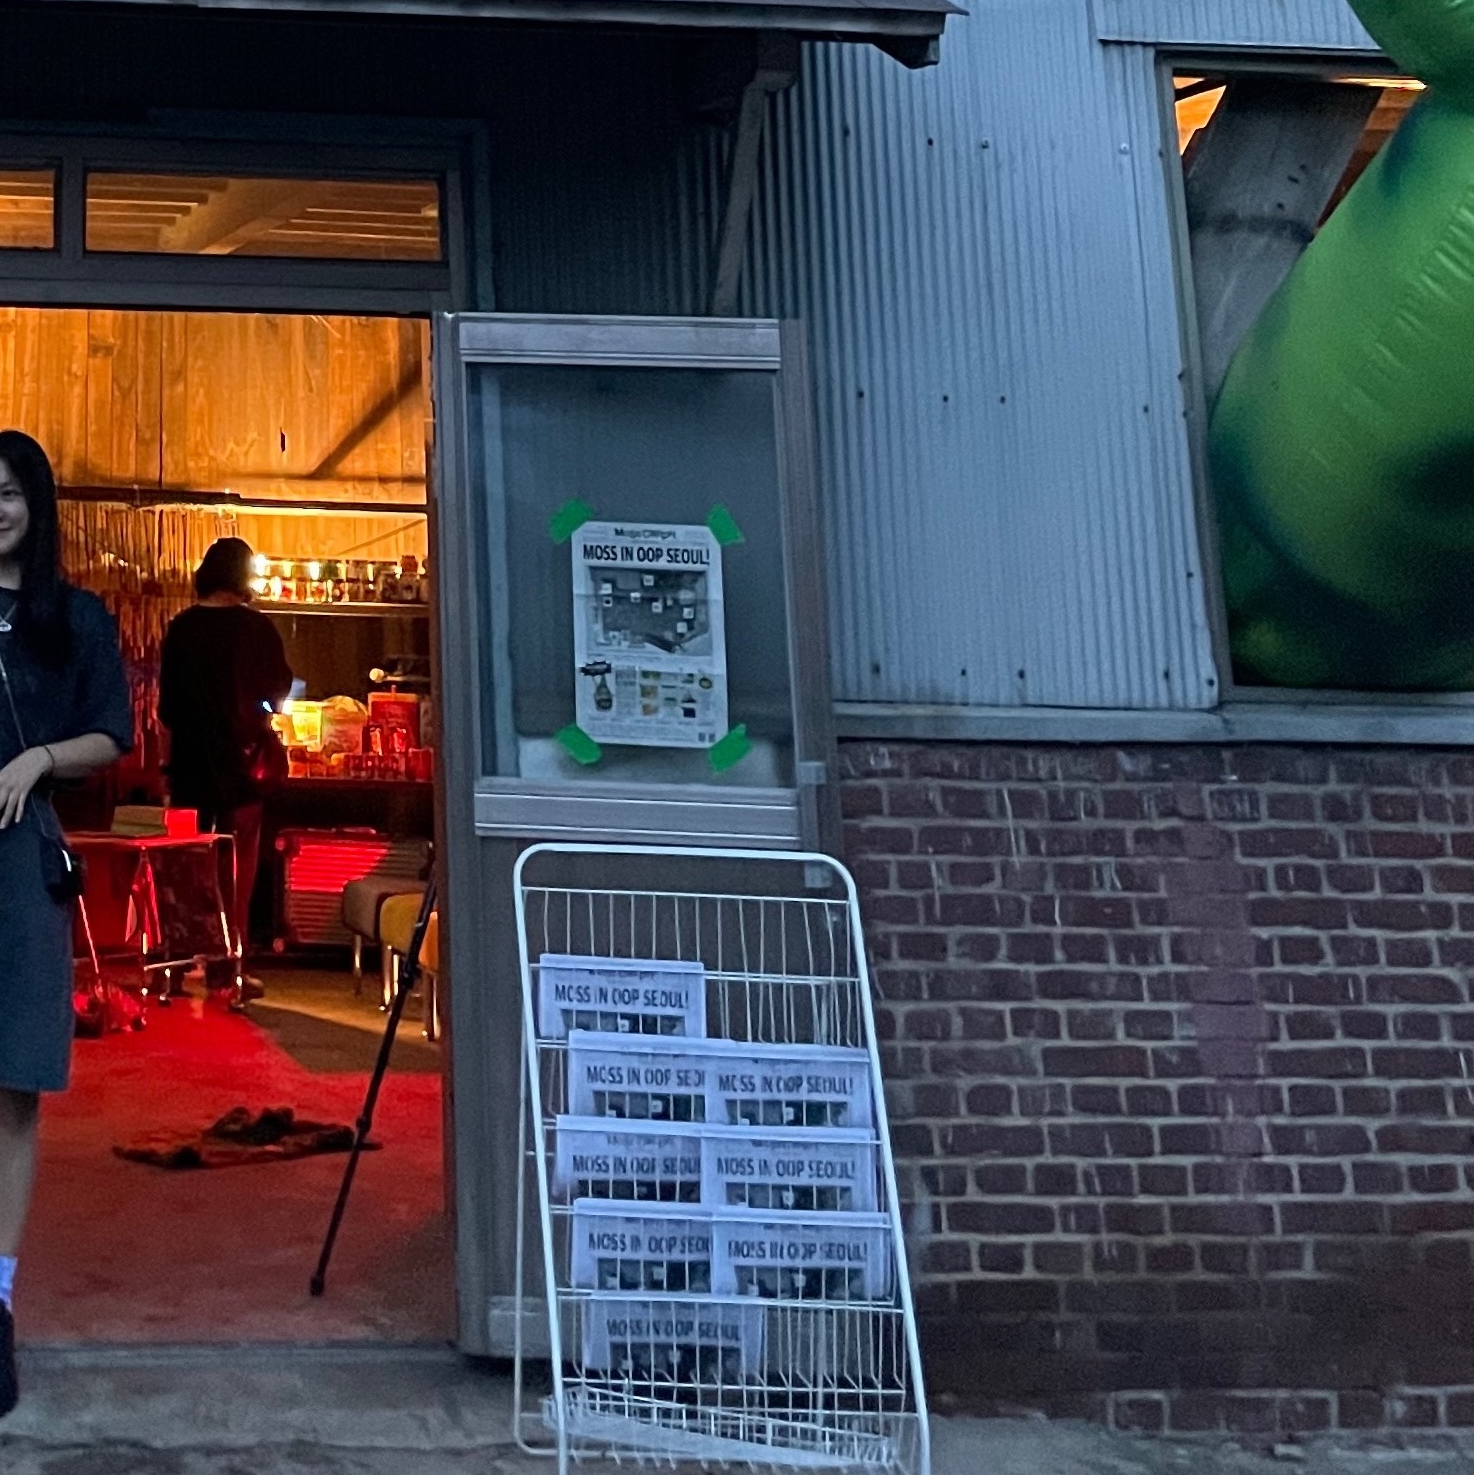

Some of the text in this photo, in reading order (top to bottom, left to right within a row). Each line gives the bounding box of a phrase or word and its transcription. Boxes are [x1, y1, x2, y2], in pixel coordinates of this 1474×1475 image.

[583, 543, 710, 565] MOSS IN OOP SEOUL!
[554, 984, 689, 1009] MOSS IN OOP SEOUL!
[586, 1064, 624, 1085] MOSS
[627, 1066, 641, 1086] IN
[644, 1067, 671, 1086] OOP
[718, 1074, 756, 1092] MOSS
[572, 1154, 610, 1173] MOSS
[613, 1155, 627, 1174] IN
[716, 1157, 755, 1176] MOSS
[775, 1159, 804, 1177] OOP
[588, 1231, 626, 1252] MOSS
